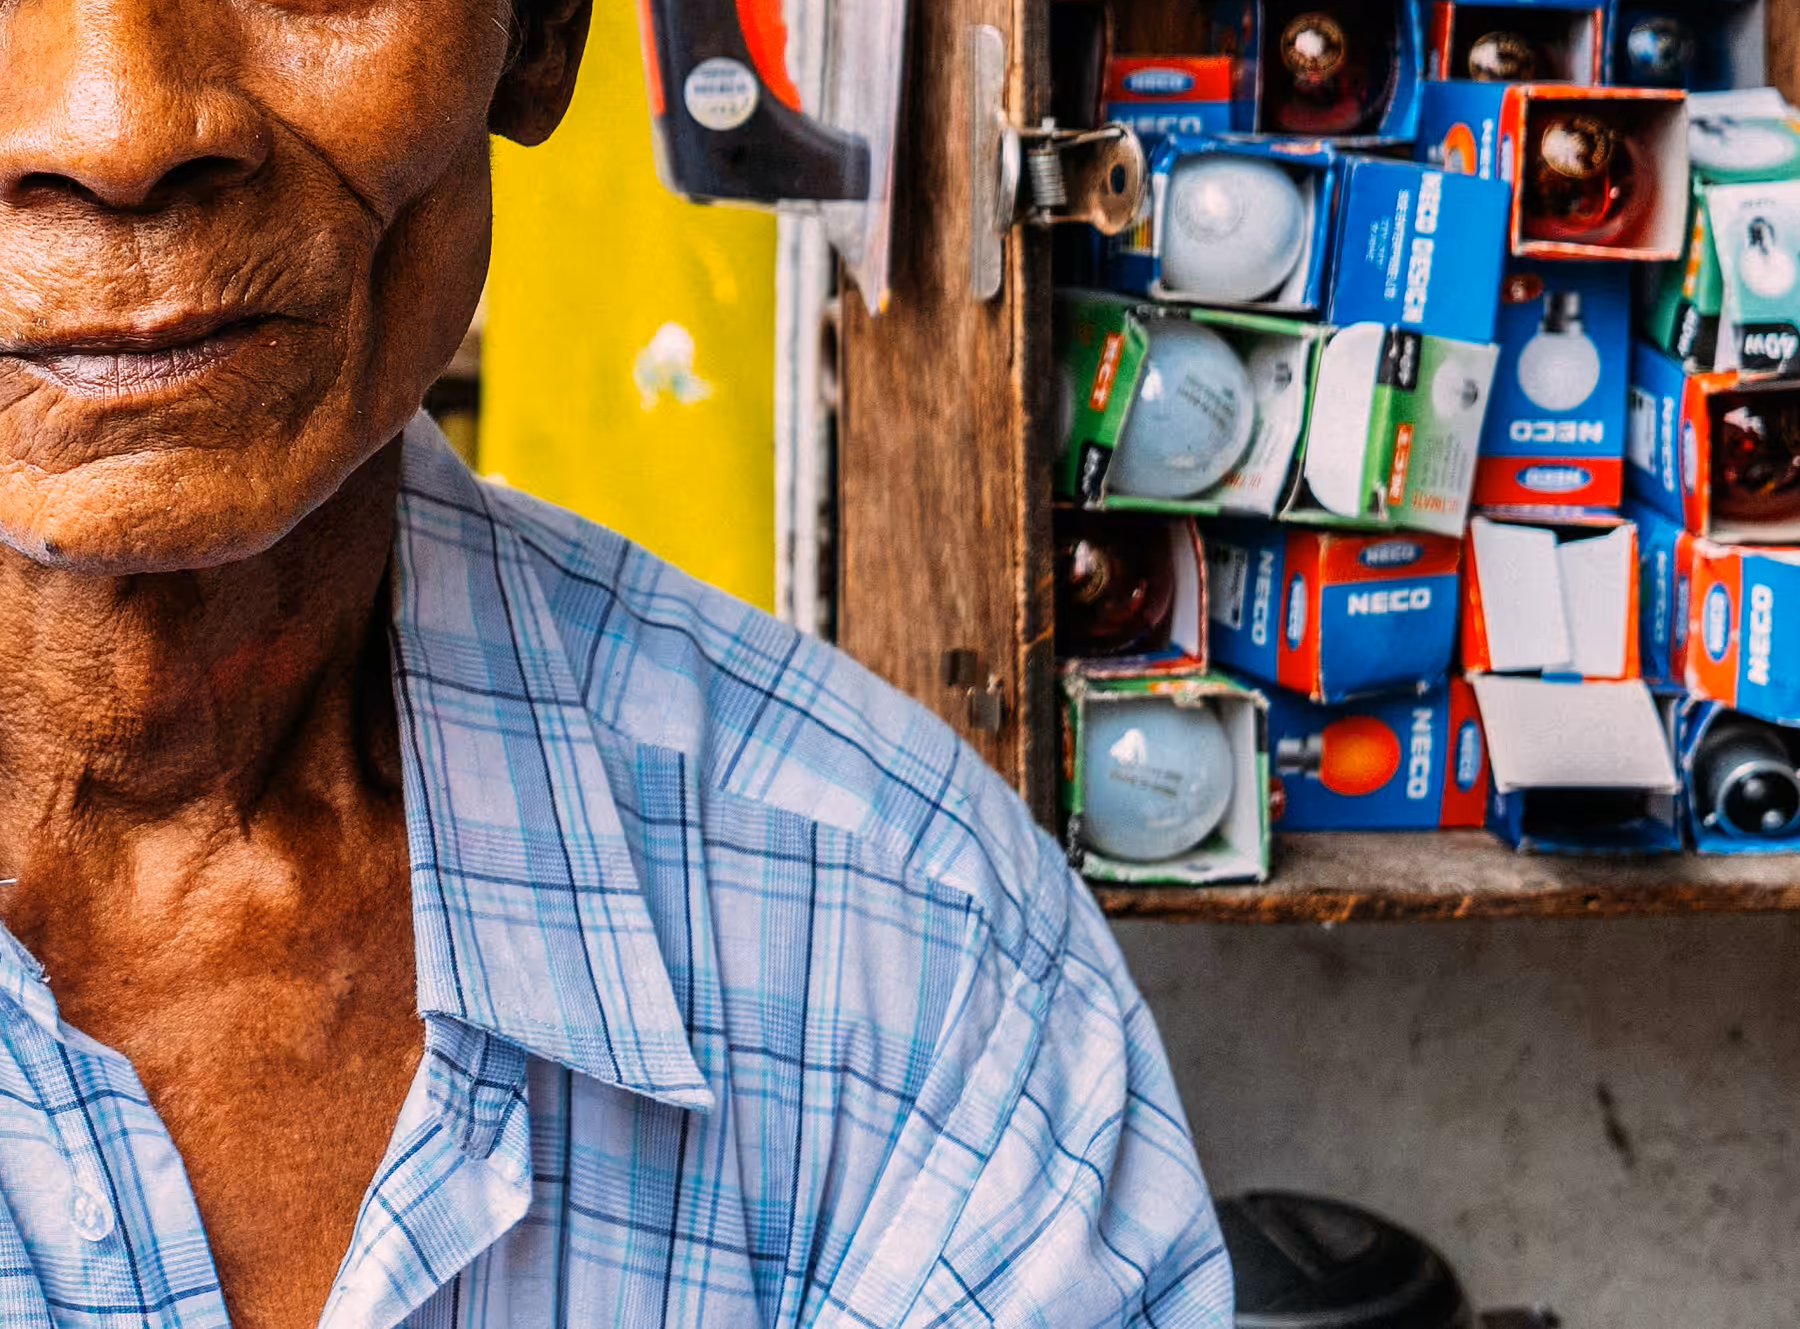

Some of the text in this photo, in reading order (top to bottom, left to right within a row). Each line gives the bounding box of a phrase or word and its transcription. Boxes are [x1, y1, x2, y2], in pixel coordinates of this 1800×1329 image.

[1510, 420, 1604, 443] NECO
[1251, 547, 1275, 647] NECO
[1347, 586, 1432, 617] NECO
[1747, 583, 1774, 687] NECO
[1406, 708, 1433, 801] NECO
